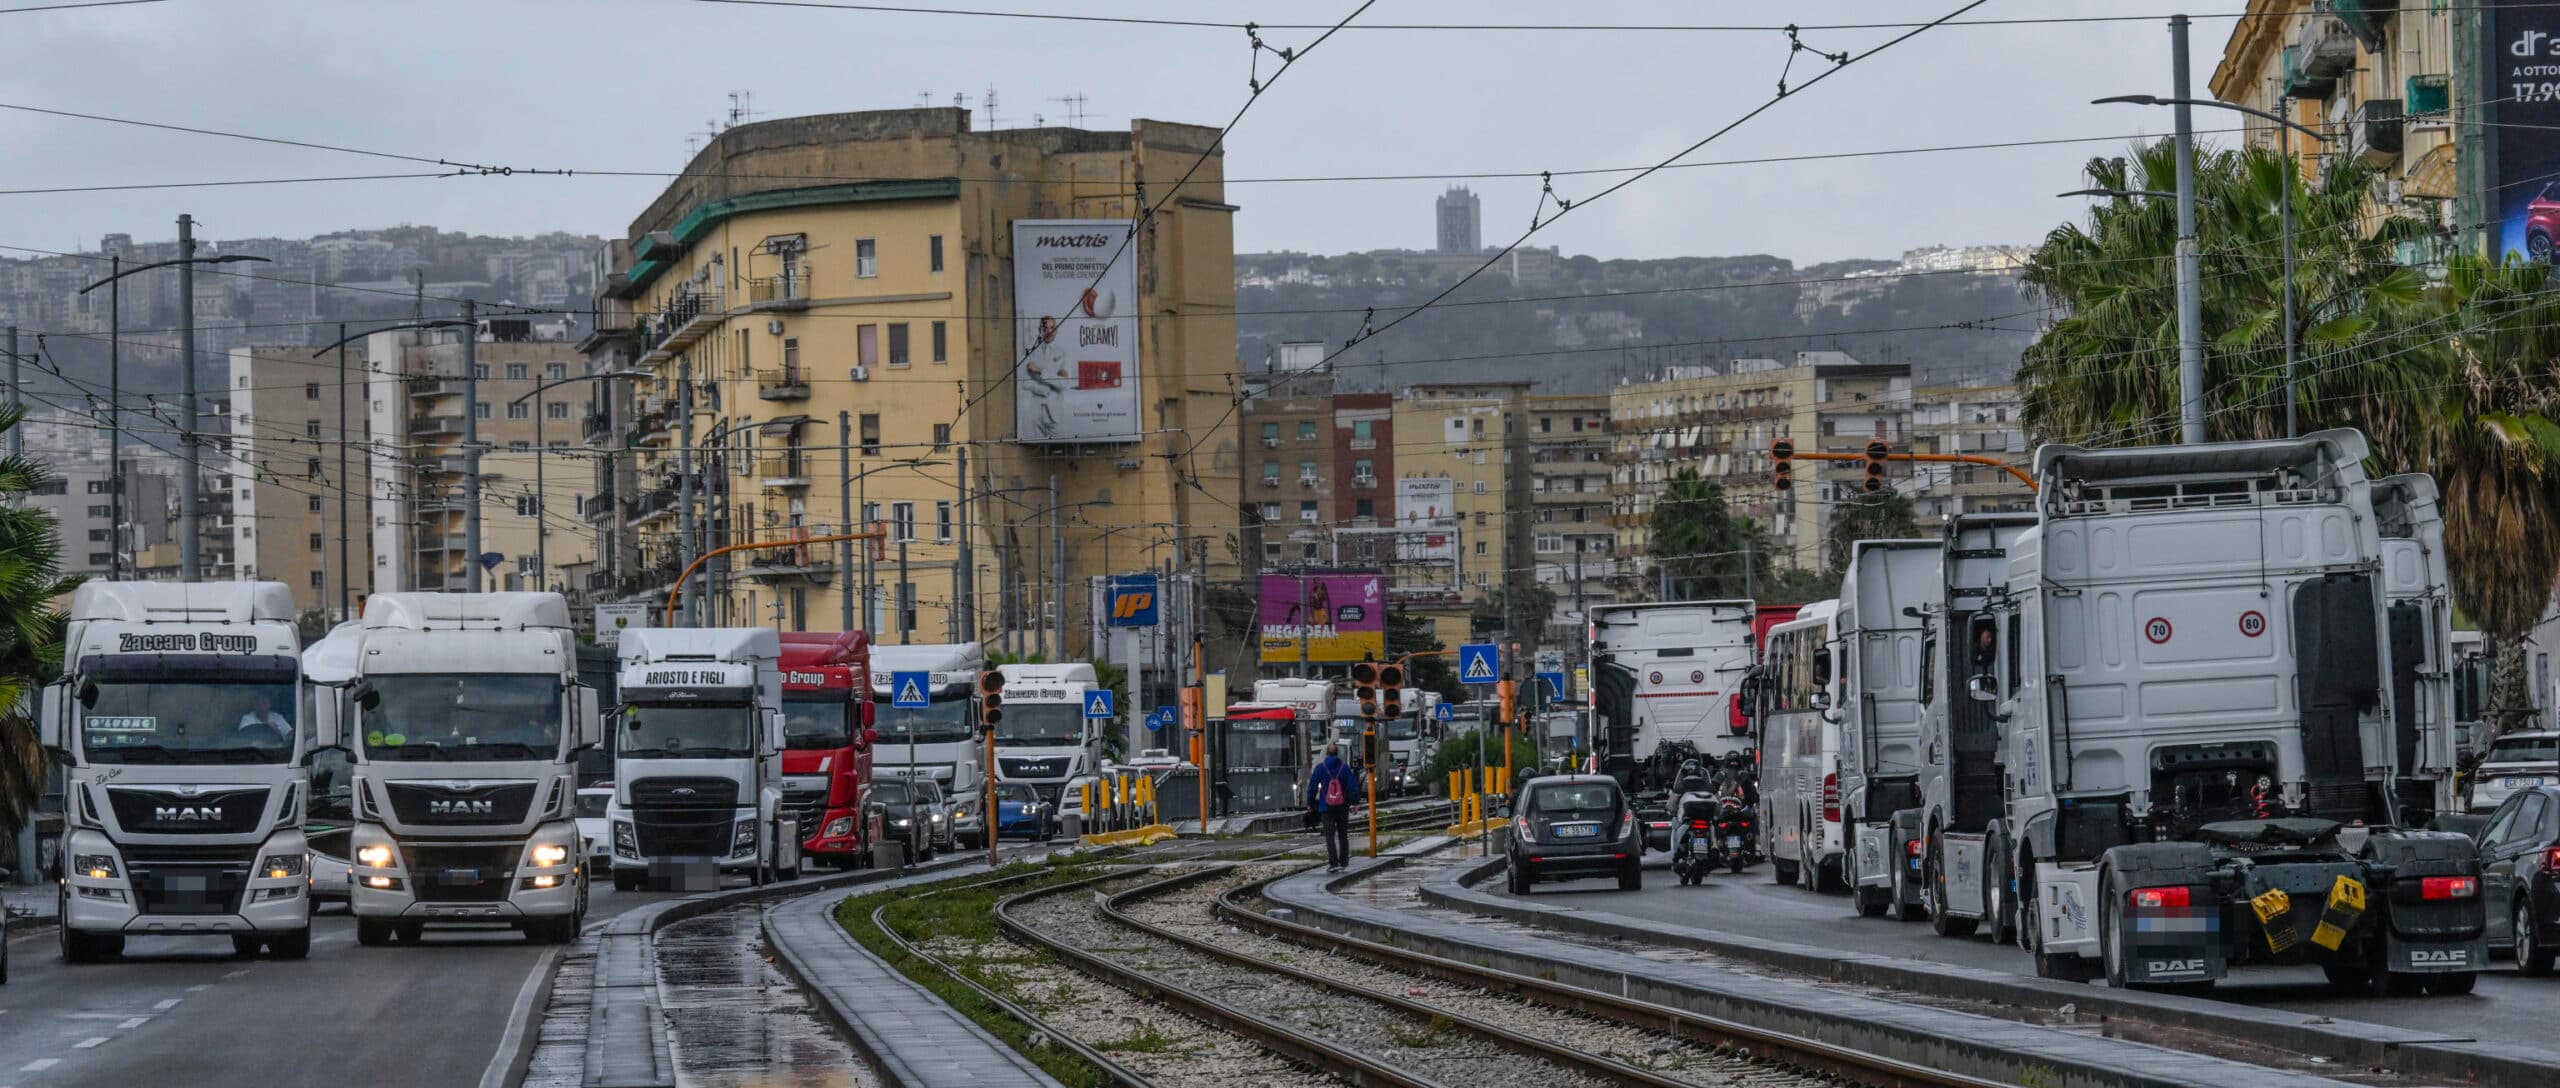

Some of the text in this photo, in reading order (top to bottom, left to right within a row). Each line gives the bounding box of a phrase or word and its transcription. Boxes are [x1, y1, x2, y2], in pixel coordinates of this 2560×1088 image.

[2513, 65, 2560, 77] A OTTO
[1036, 233, 1109, 248] maxtris
[1080, 325, 1119, 348] CREAMY!
[2152, 625, 2166, 636] 70
[2245, 618, 2259, 630] 80
[1263, 624, 1301, 639] MEGA
[119, 632, 257, 655] Zaccaro Group
[645, 672, 725, 685] ARIOSTO E FIGLI
[790, 670, 825, 687] Group
[1020, 764, 1051, 772] MAN
[430, 800, 493, 814] MAN
[156, 807, 221, 821] MAN
[2412, 950, 2466, 961] DAF
[2149, 959, 2204, 971] DAF
